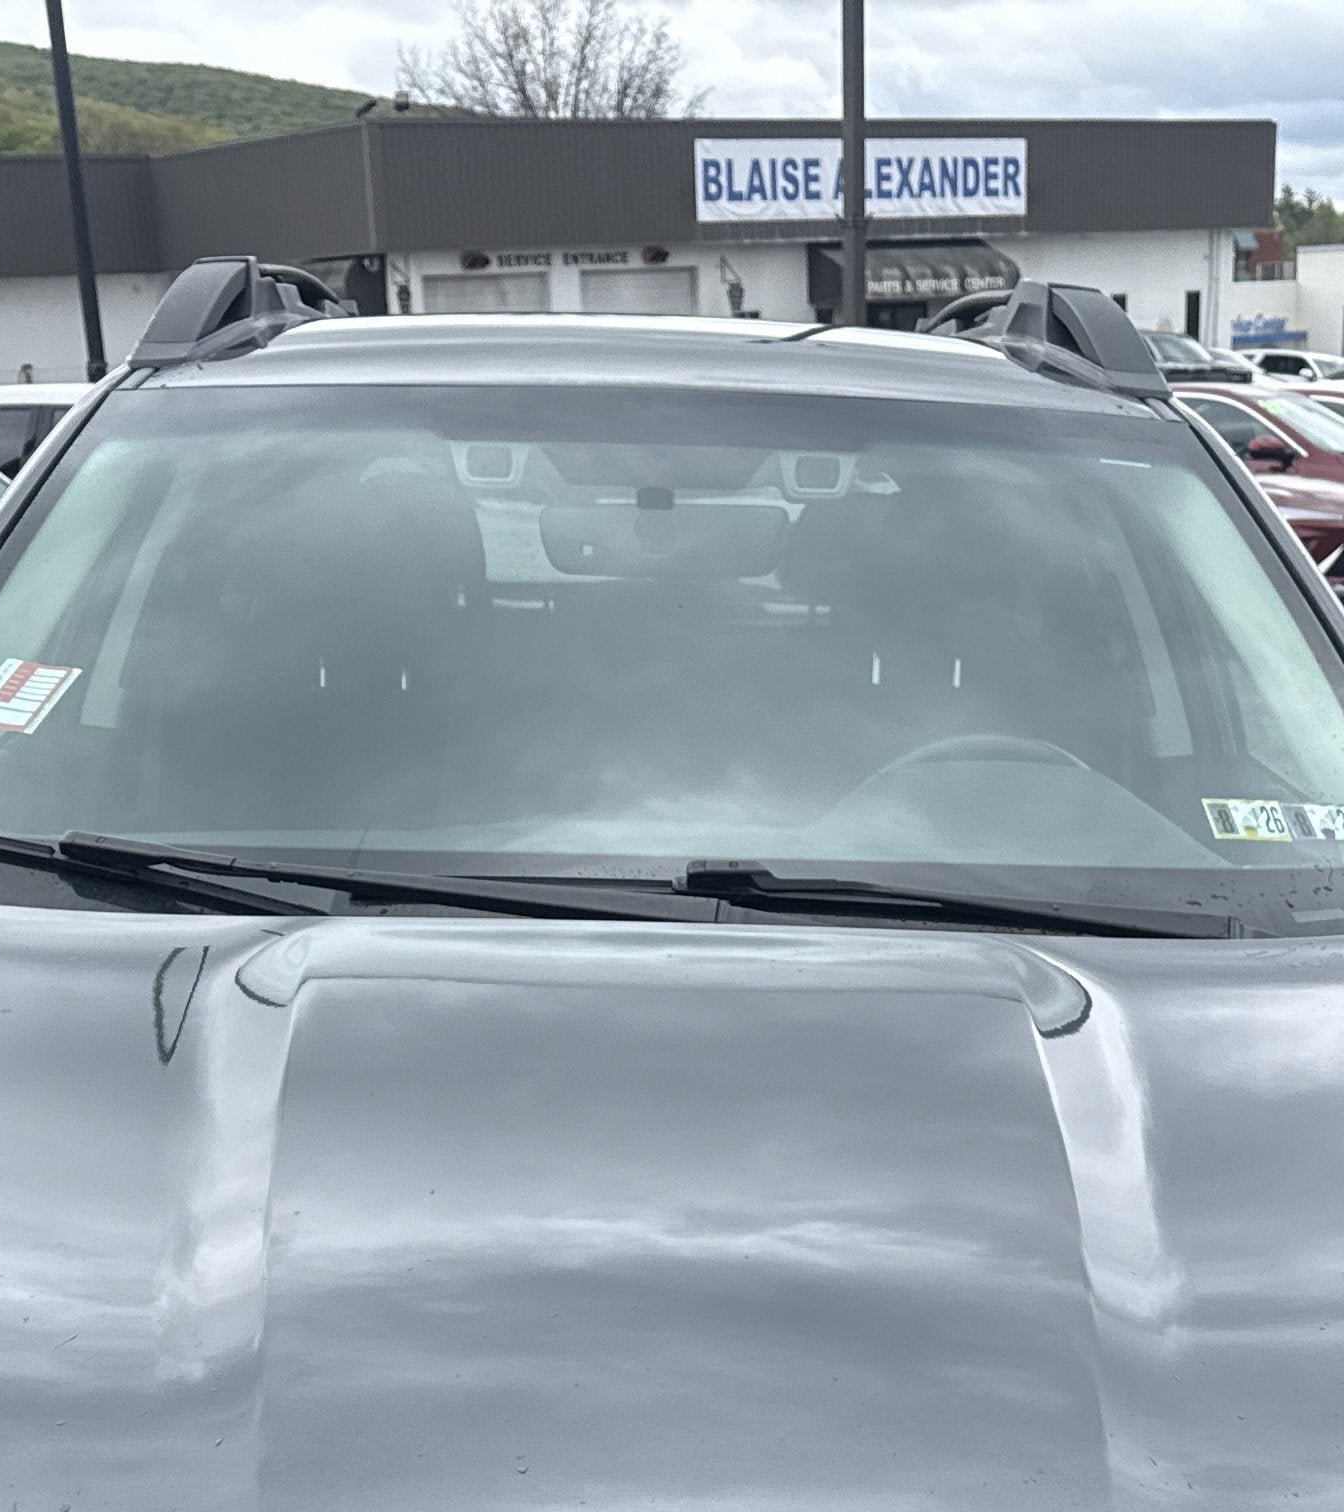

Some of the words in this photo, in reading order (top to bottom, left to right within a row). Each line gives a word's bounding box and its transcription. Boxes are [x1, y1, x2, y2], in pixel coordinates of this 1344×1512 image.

[702, 157, 822, 201] BLAISE
[834, 156, 1021, 200] AEXANDER
[496, 253, 552, 268] SERVICE
[561, 250, 628, 265] ENTRANCE
[867, 279, 901, 293] PARTS
[915, 278, 959, 292] SERVICE
[965, 276, 1005, 290] CENTER
[1260, 806, 1285, 834] 26
